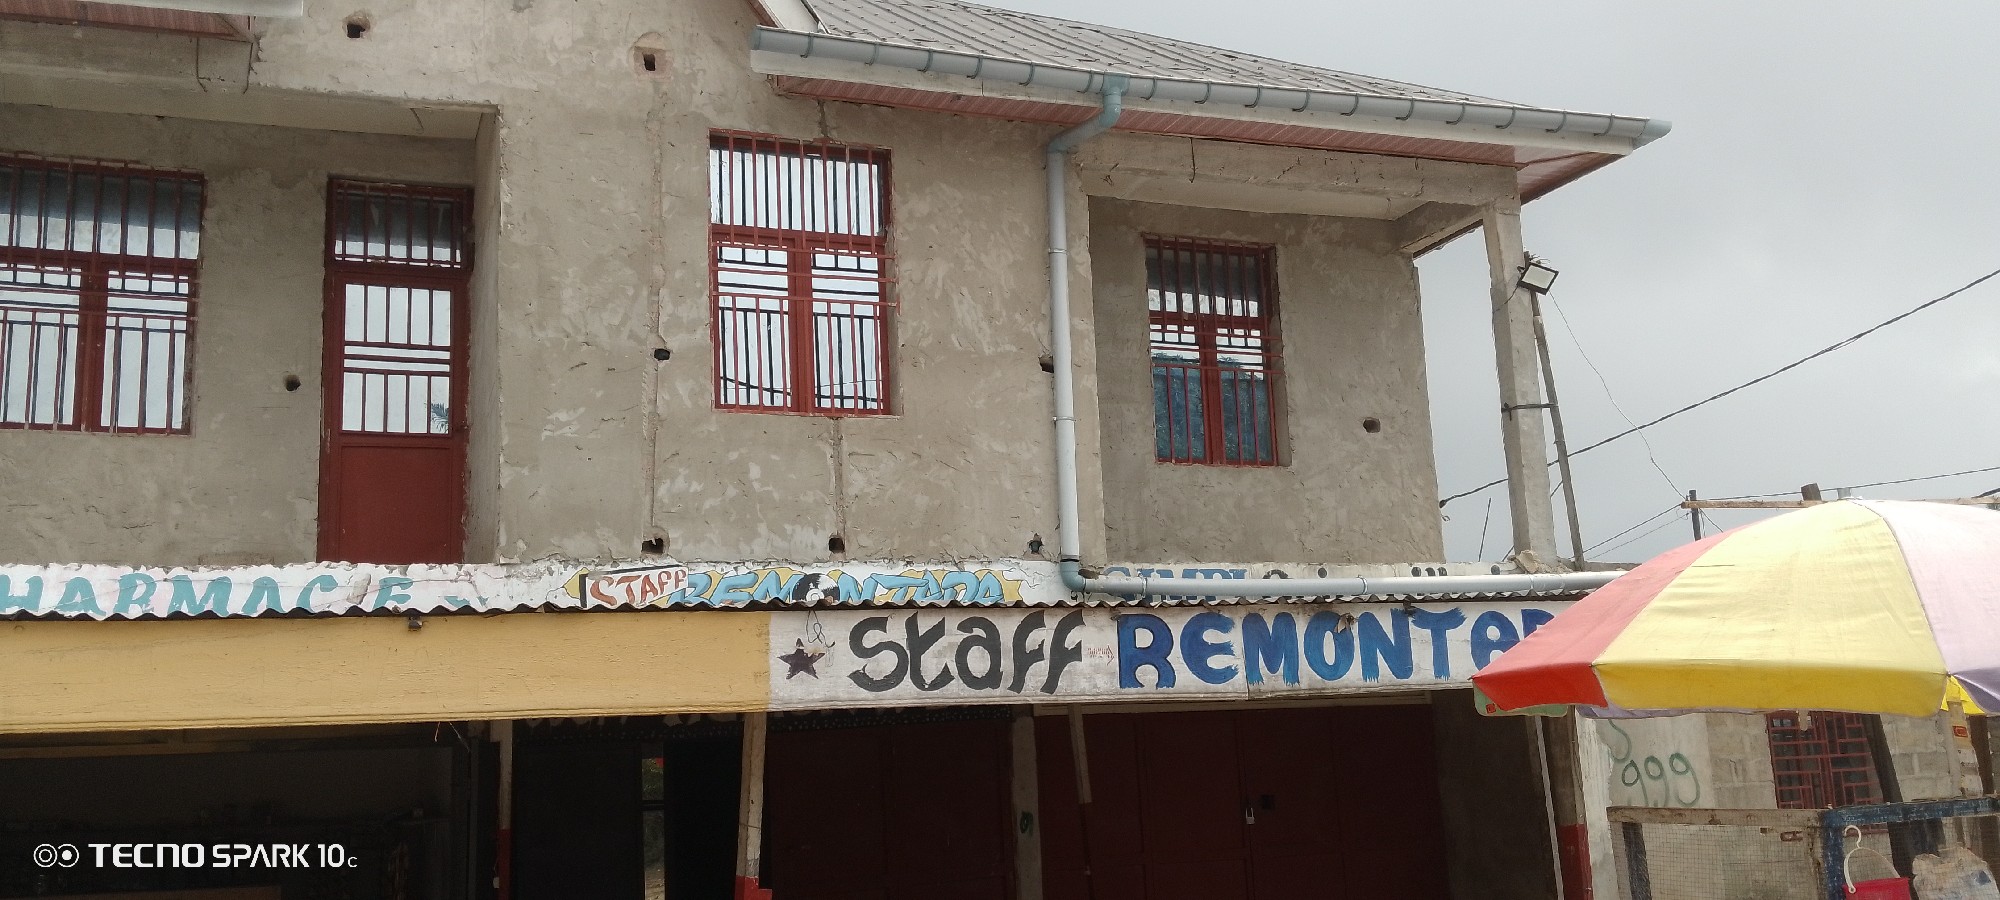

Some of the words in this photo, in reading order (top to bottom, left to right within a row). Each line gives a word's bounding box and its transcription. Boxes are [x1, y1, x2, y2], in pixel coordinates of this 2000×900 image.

[0, 573, 413, 617] HARMACE
[590, 570, 687, 606] STAFF
[847, 608, 1085, 695] Staff
